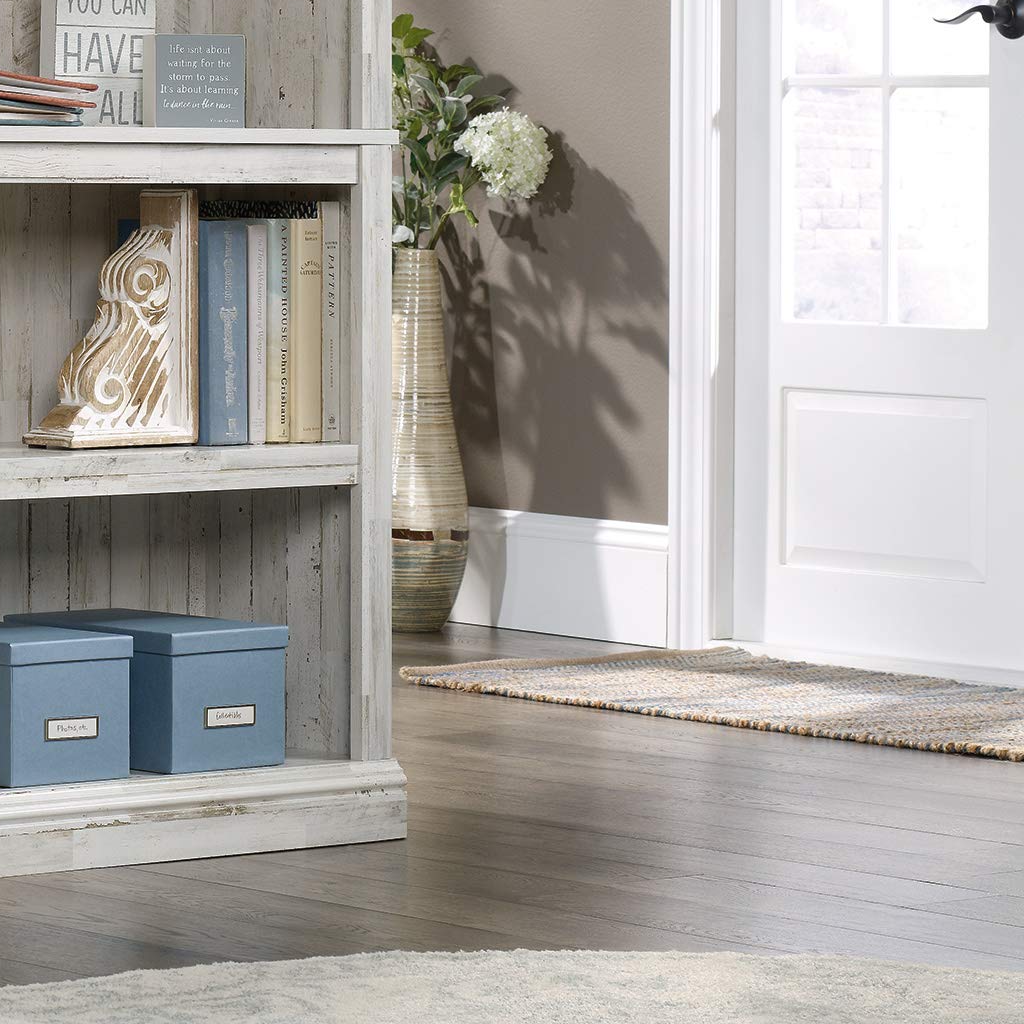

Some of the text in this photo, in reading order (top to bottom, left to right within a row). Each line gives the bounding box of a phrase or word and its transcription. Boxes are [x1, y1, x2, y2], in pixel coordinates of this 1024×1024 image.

[63, 32, 143, 74] HAVE
[169, 44, 185, 53] life
[206, 45, 231, 54] about
[168, 58, 232, 69] waiting for the
[168, 73, 193, 81] storm
[196, 73, 206, 81] to
[160, 84, 239, 95] It's about learning
[201, 98, 215, 109] the
[281, 225, 287, 233] A
[280, 347, 288, 374] John
[280, 378, 288, 425] Grisham
